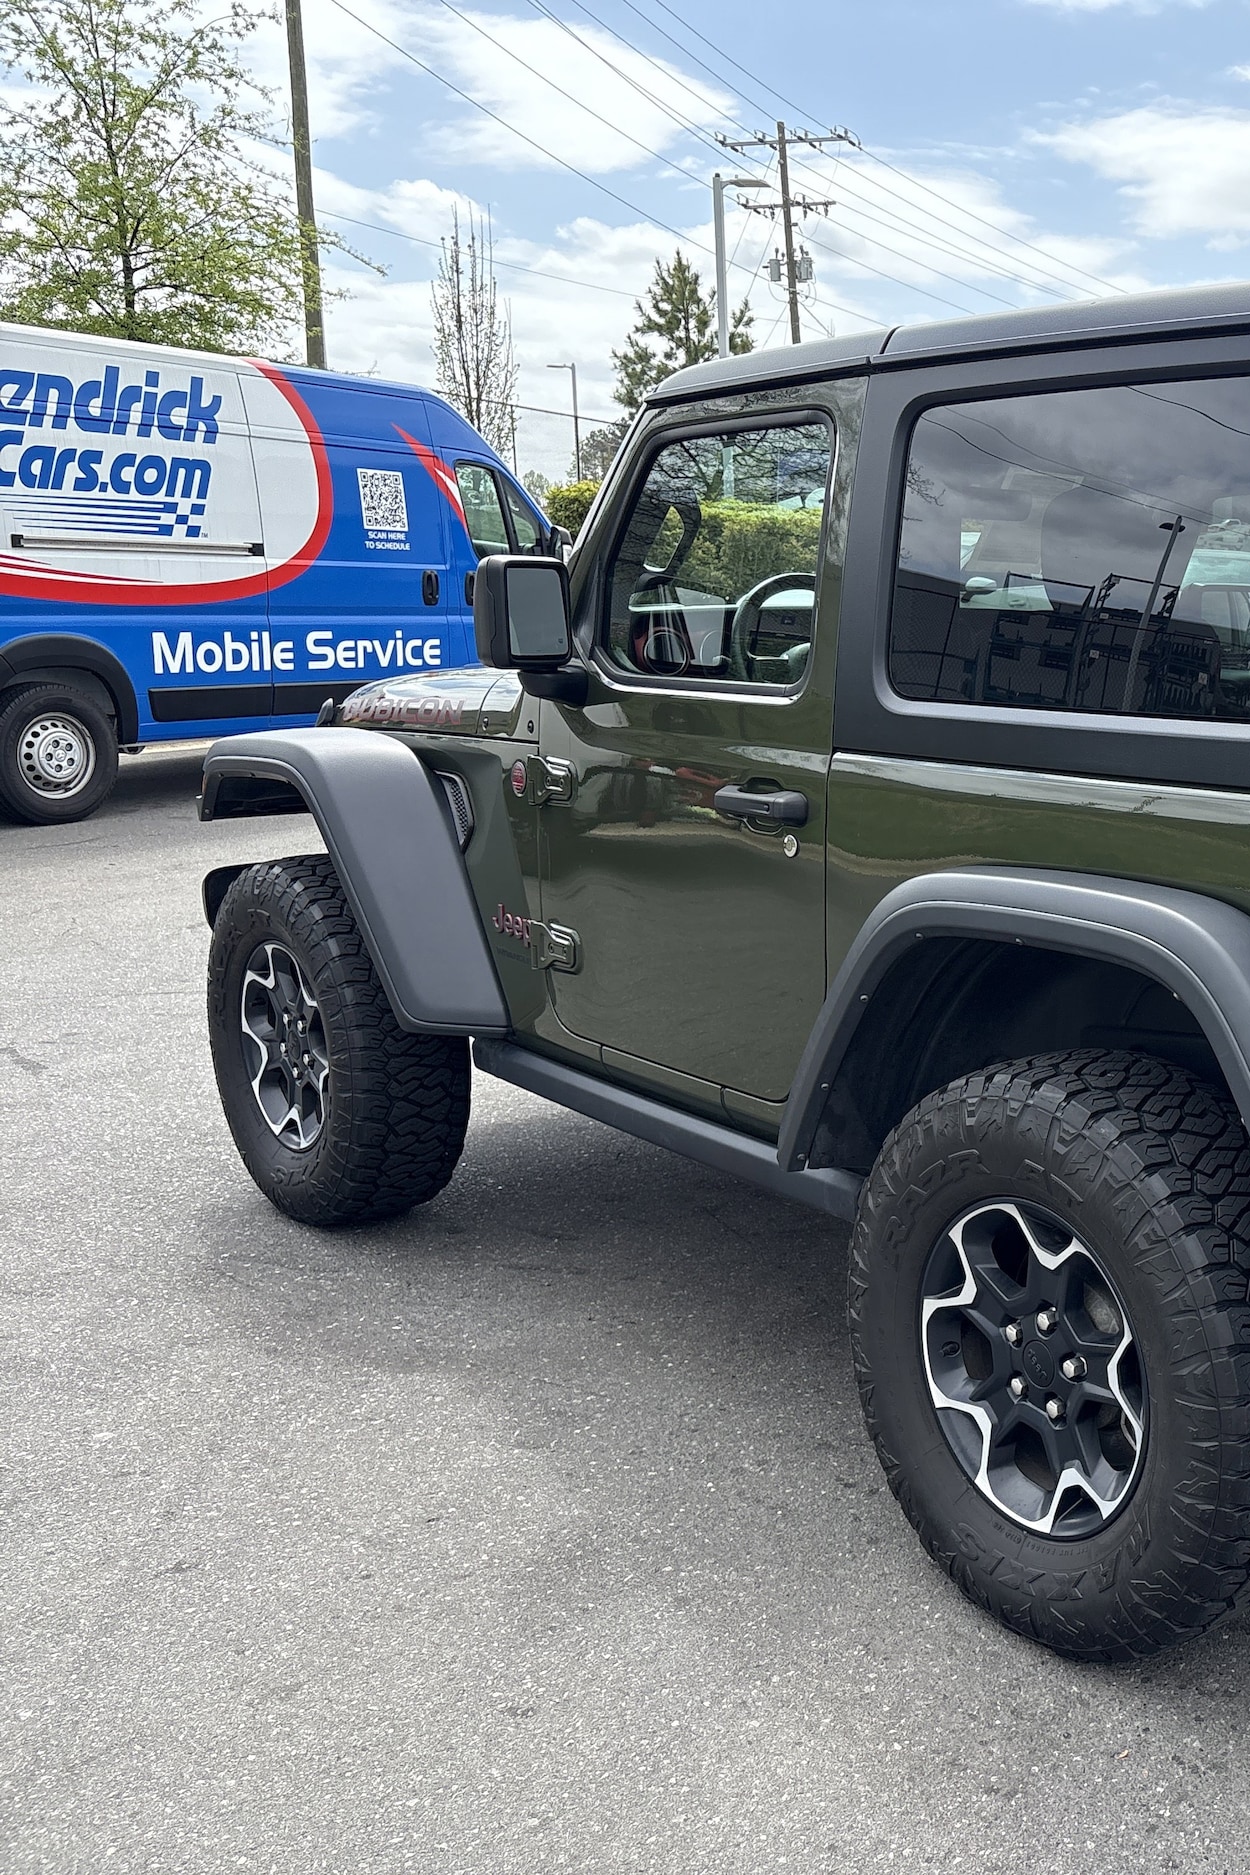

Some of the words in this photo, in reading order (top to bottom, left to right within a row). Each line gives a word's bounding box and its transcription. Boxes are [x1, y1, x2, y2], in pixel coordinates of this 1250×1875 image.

[0, 429, 212, 499] Cars.com
[364, 540, 375, 549] TO
[375, 541, 411, 551] SCHEDULE
[367, 530, 387, 540] SCAN
[387, 532, 407, 541] HERE
[152, 631, 295, 674] Mobile
[306, 630, 441, 670] Service
[342, 698, 466, 725] RUBICON
[492, 904, 531, 948] Jeep
[951, 1503, 1151, 1601] MAXXIS
